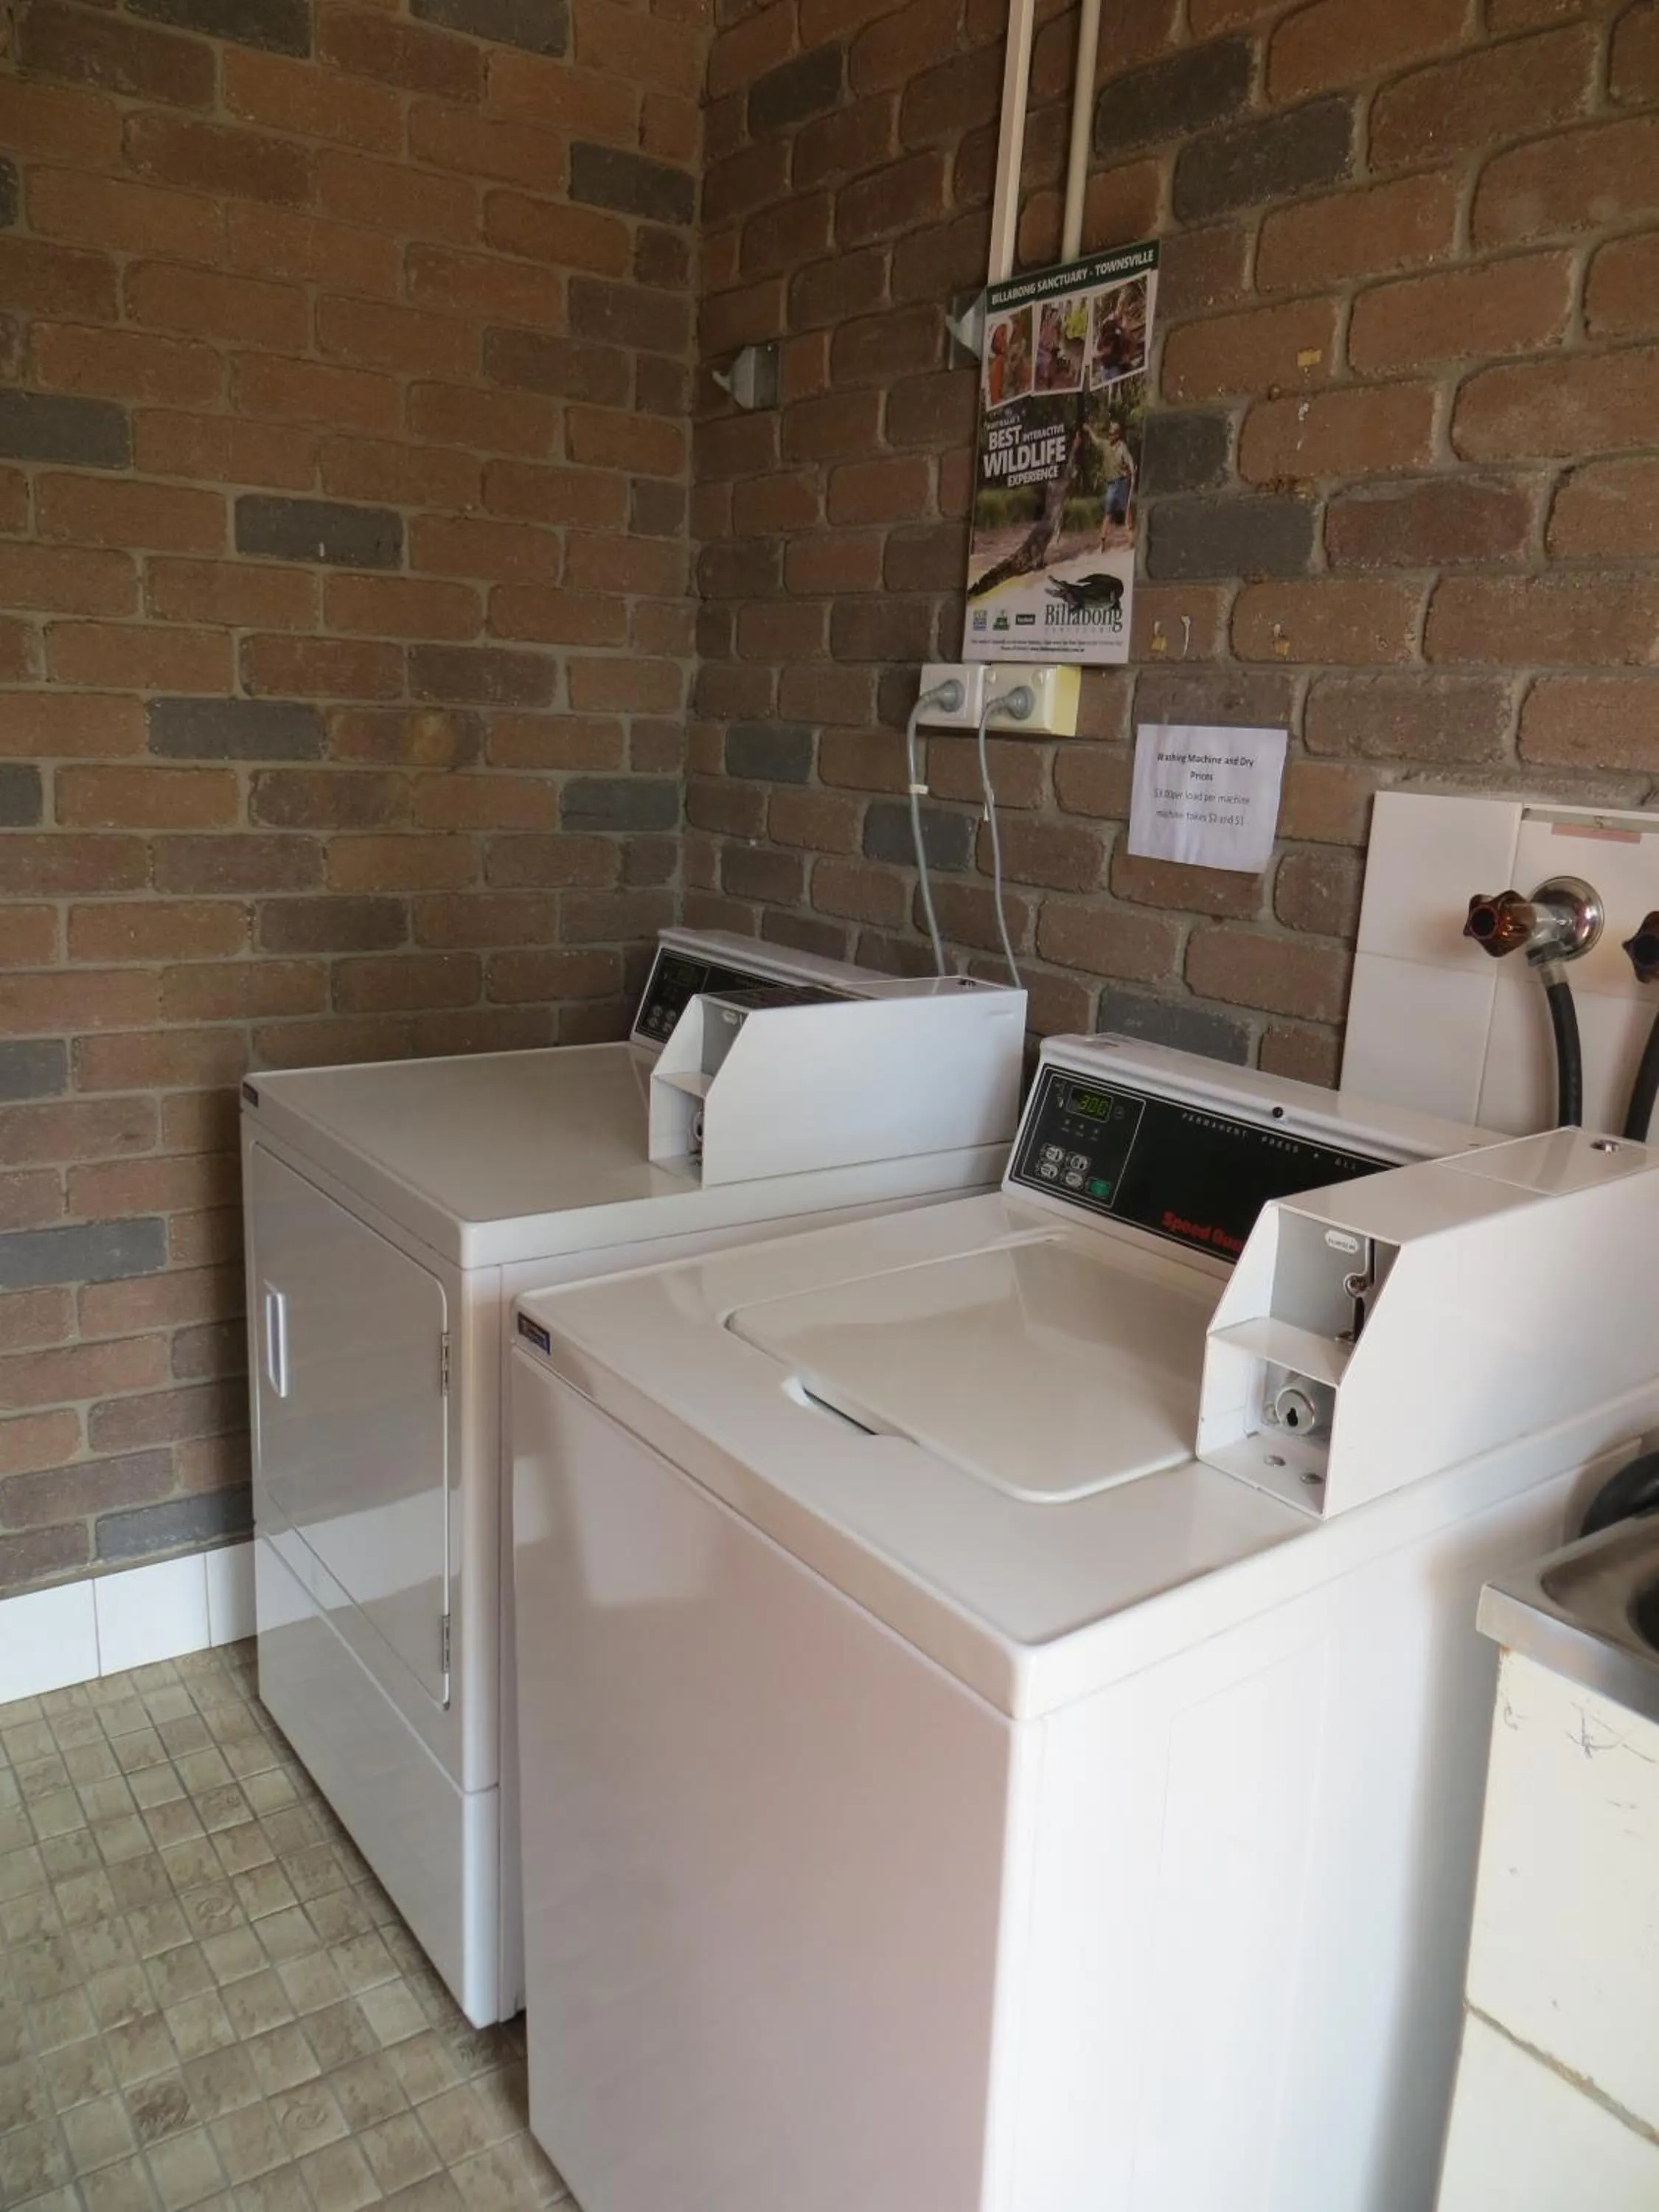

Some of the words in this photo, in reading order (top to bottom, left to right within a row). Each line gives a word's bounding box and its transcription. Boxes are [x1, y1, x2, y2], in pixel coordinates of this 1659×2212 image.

[992, 282, 1036, 305] BILLABONG
[1037, 268, 1088, 293] SANCTUARY
[1095, 249, 1155, 277] TOWNSVILLE
[989, 425, 1023, 451] BEST
[983, 436, 1066, 479] WILDLIFE
[1007, 465, 1060, 487] EXPERIENCE
[1044, 603, 1123, 633] Billabong
[1157, 753, 1186, 765] Washing
[1188, 754, 1222, 765] Machine
[1225, 757, 1239, 766] and
[1240, 757, 1254, 768] Dry
[1190, 771, 1214, 781] Prices
[1162, 1210, 1211, 1241] Speed
